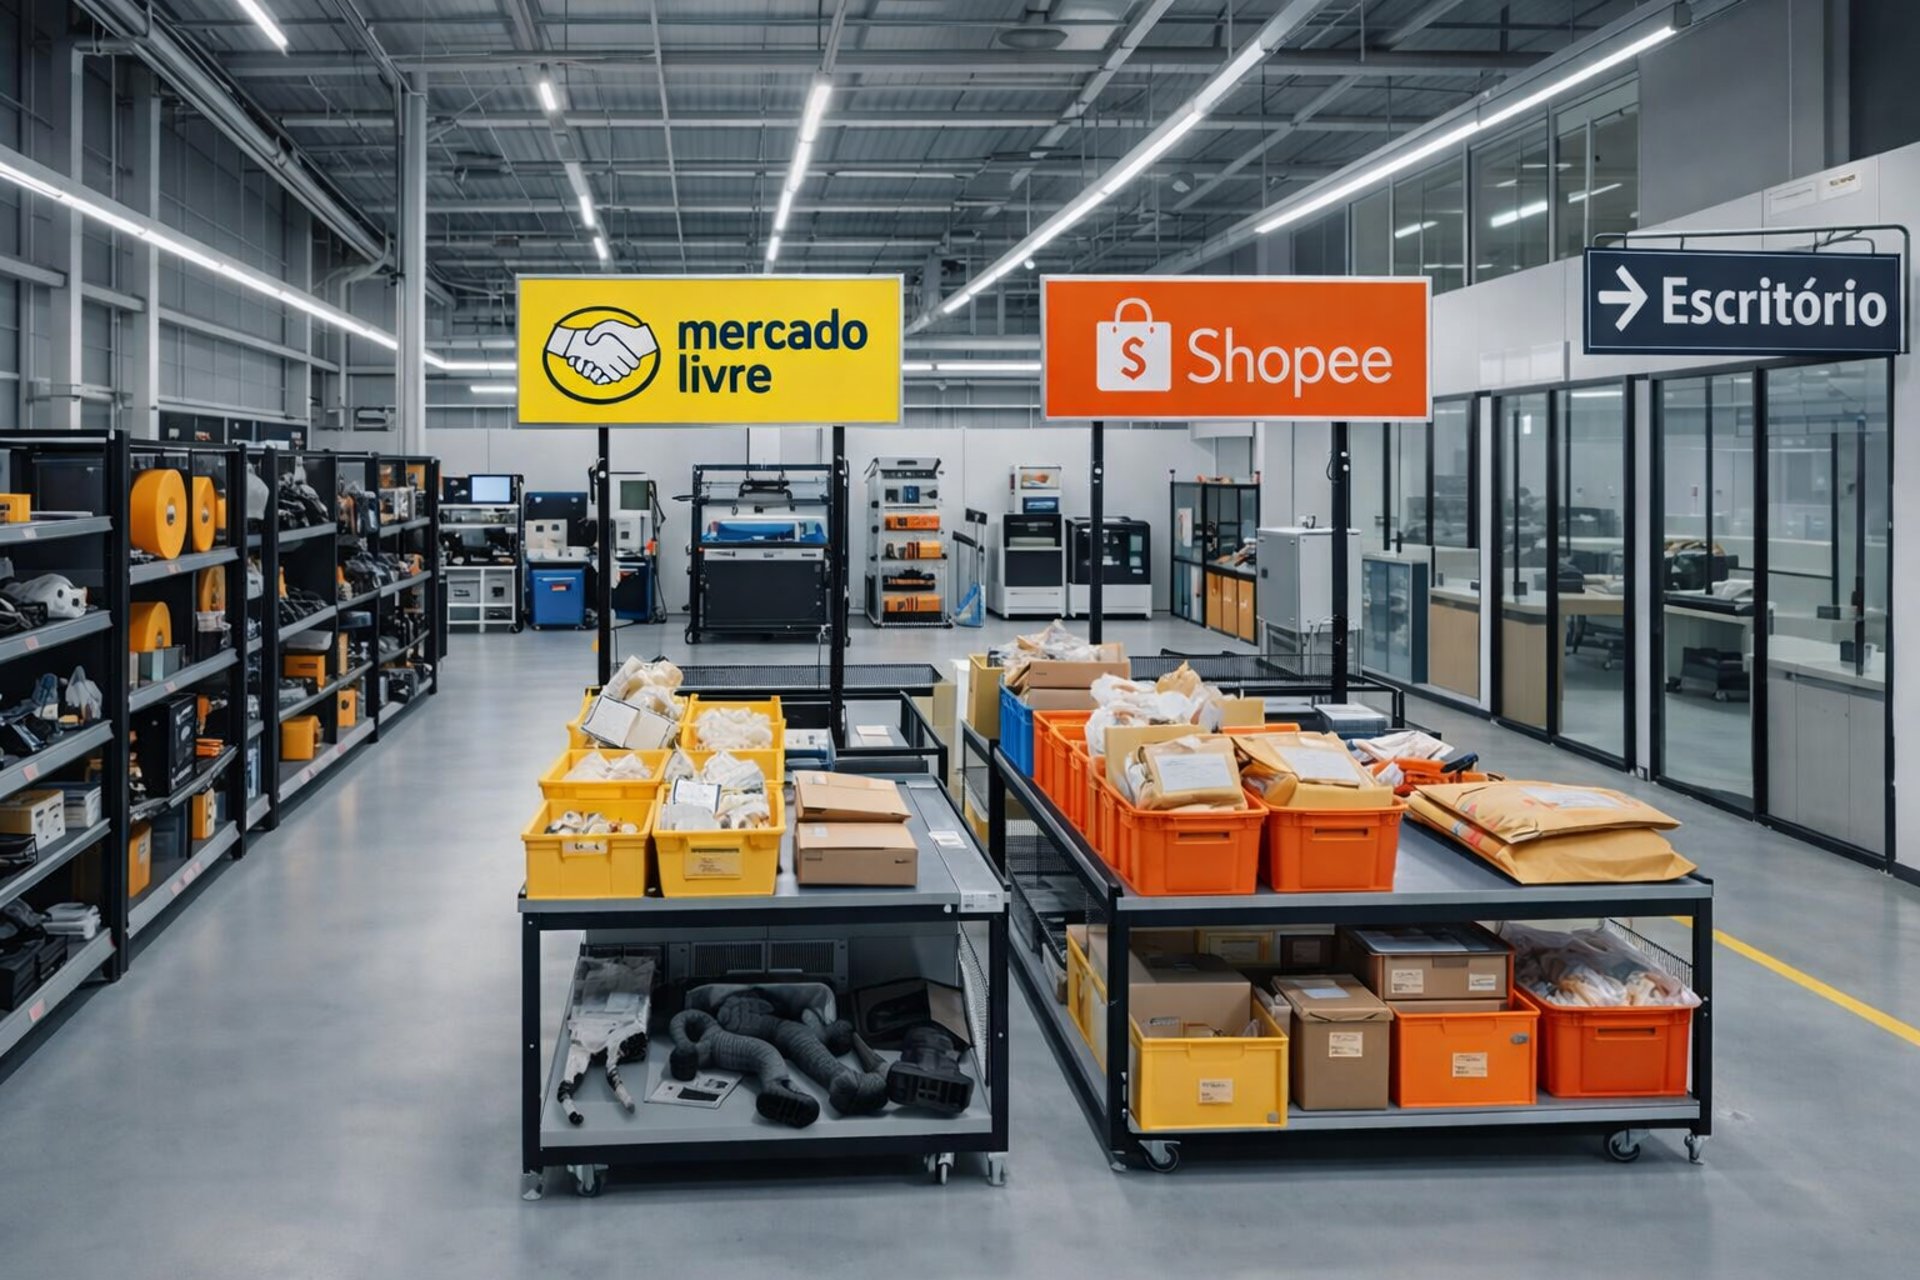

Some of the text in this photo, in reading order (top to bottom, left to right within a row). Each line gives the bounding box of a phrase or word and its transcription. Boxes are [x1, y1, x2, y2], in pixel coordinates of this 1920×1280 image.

[1662, 276, 1887, 327] Escritório
[678, 308, 868, 350] mercado
[678, 353, 772, 393] livre
[1187, 327, 1393, 398] Shopee
